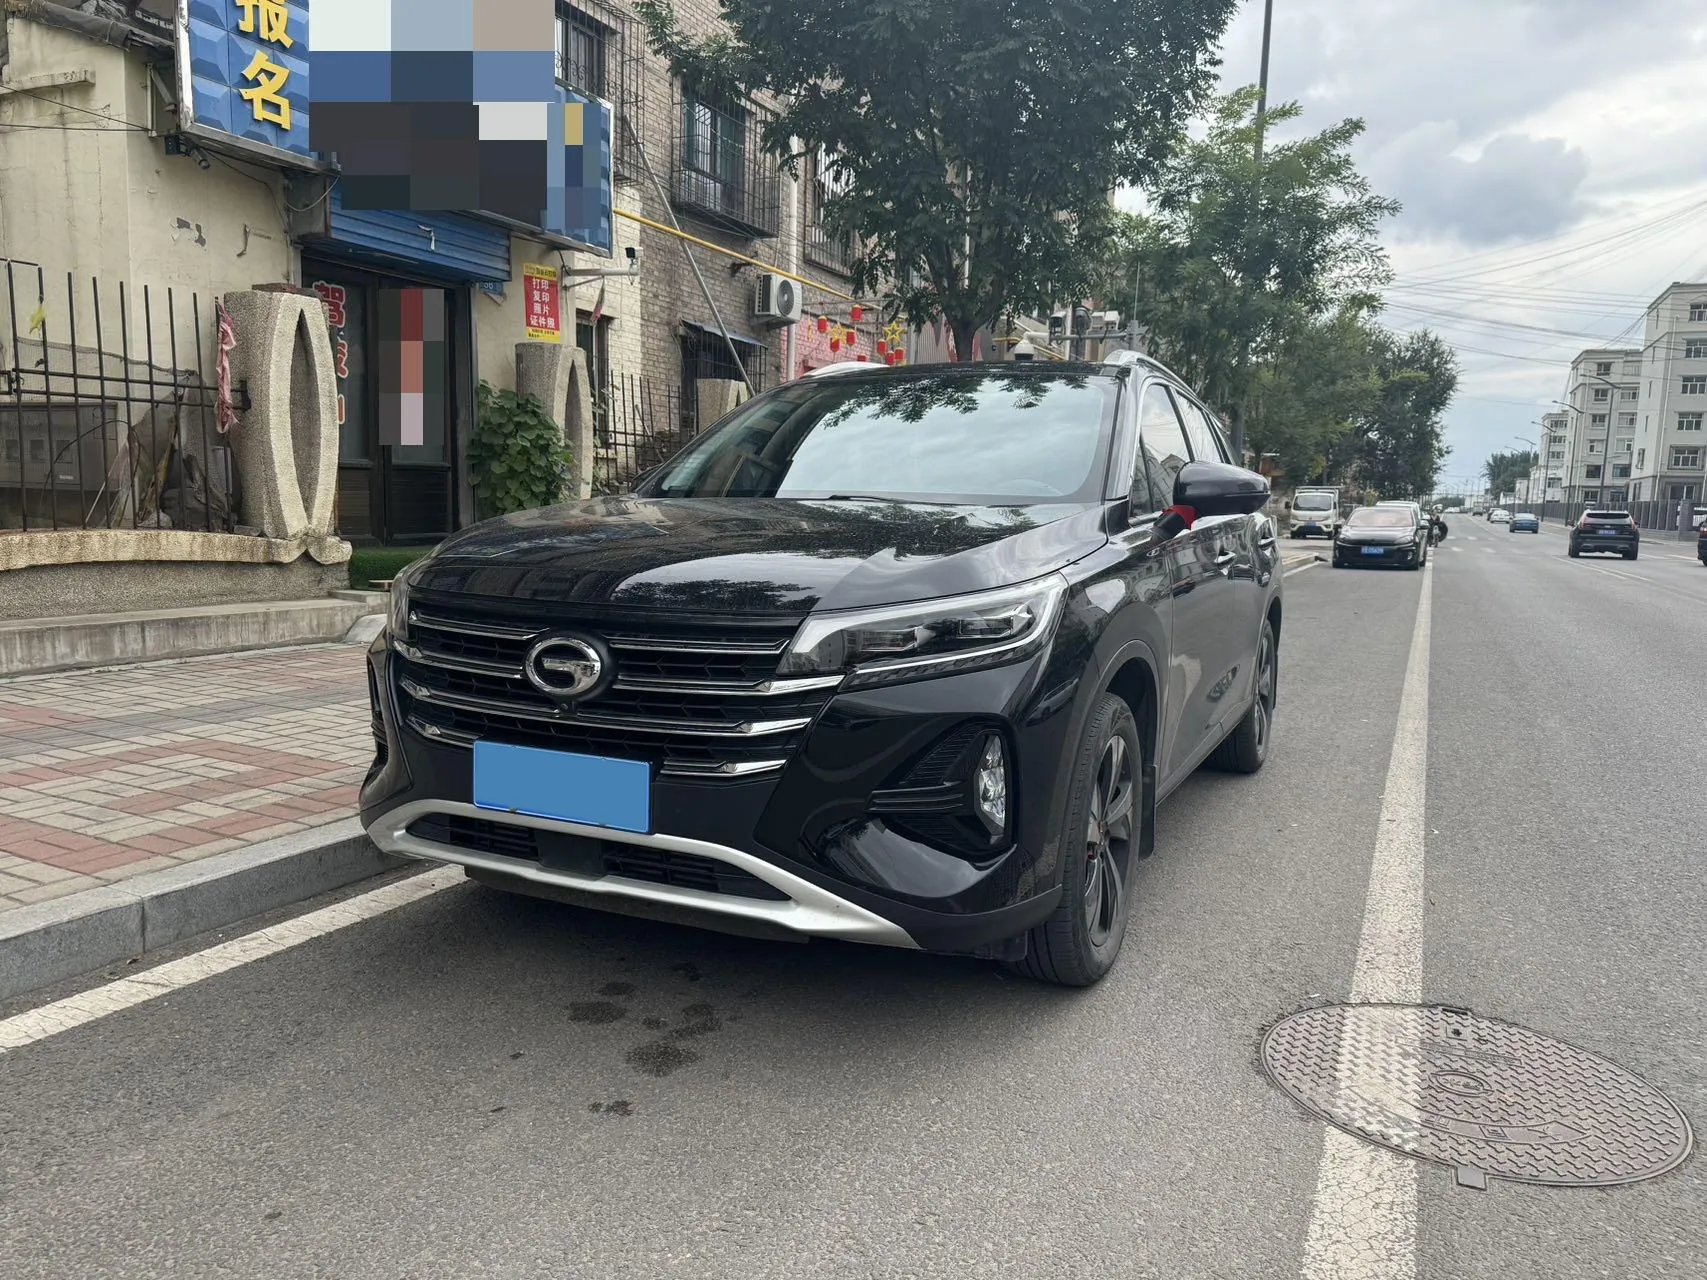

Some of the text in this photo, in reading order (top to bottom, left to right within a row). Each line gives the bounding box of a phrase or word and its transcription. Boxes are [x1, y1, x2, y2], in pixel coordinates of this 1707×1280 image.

[235, 0, 294, 131] 报名
[532, 278, 549, 291] 打印
[533, 291, 550, 303] 复印
[533, 303, 550, 316] 照片
[529, 314, 555, 329] 证件照
